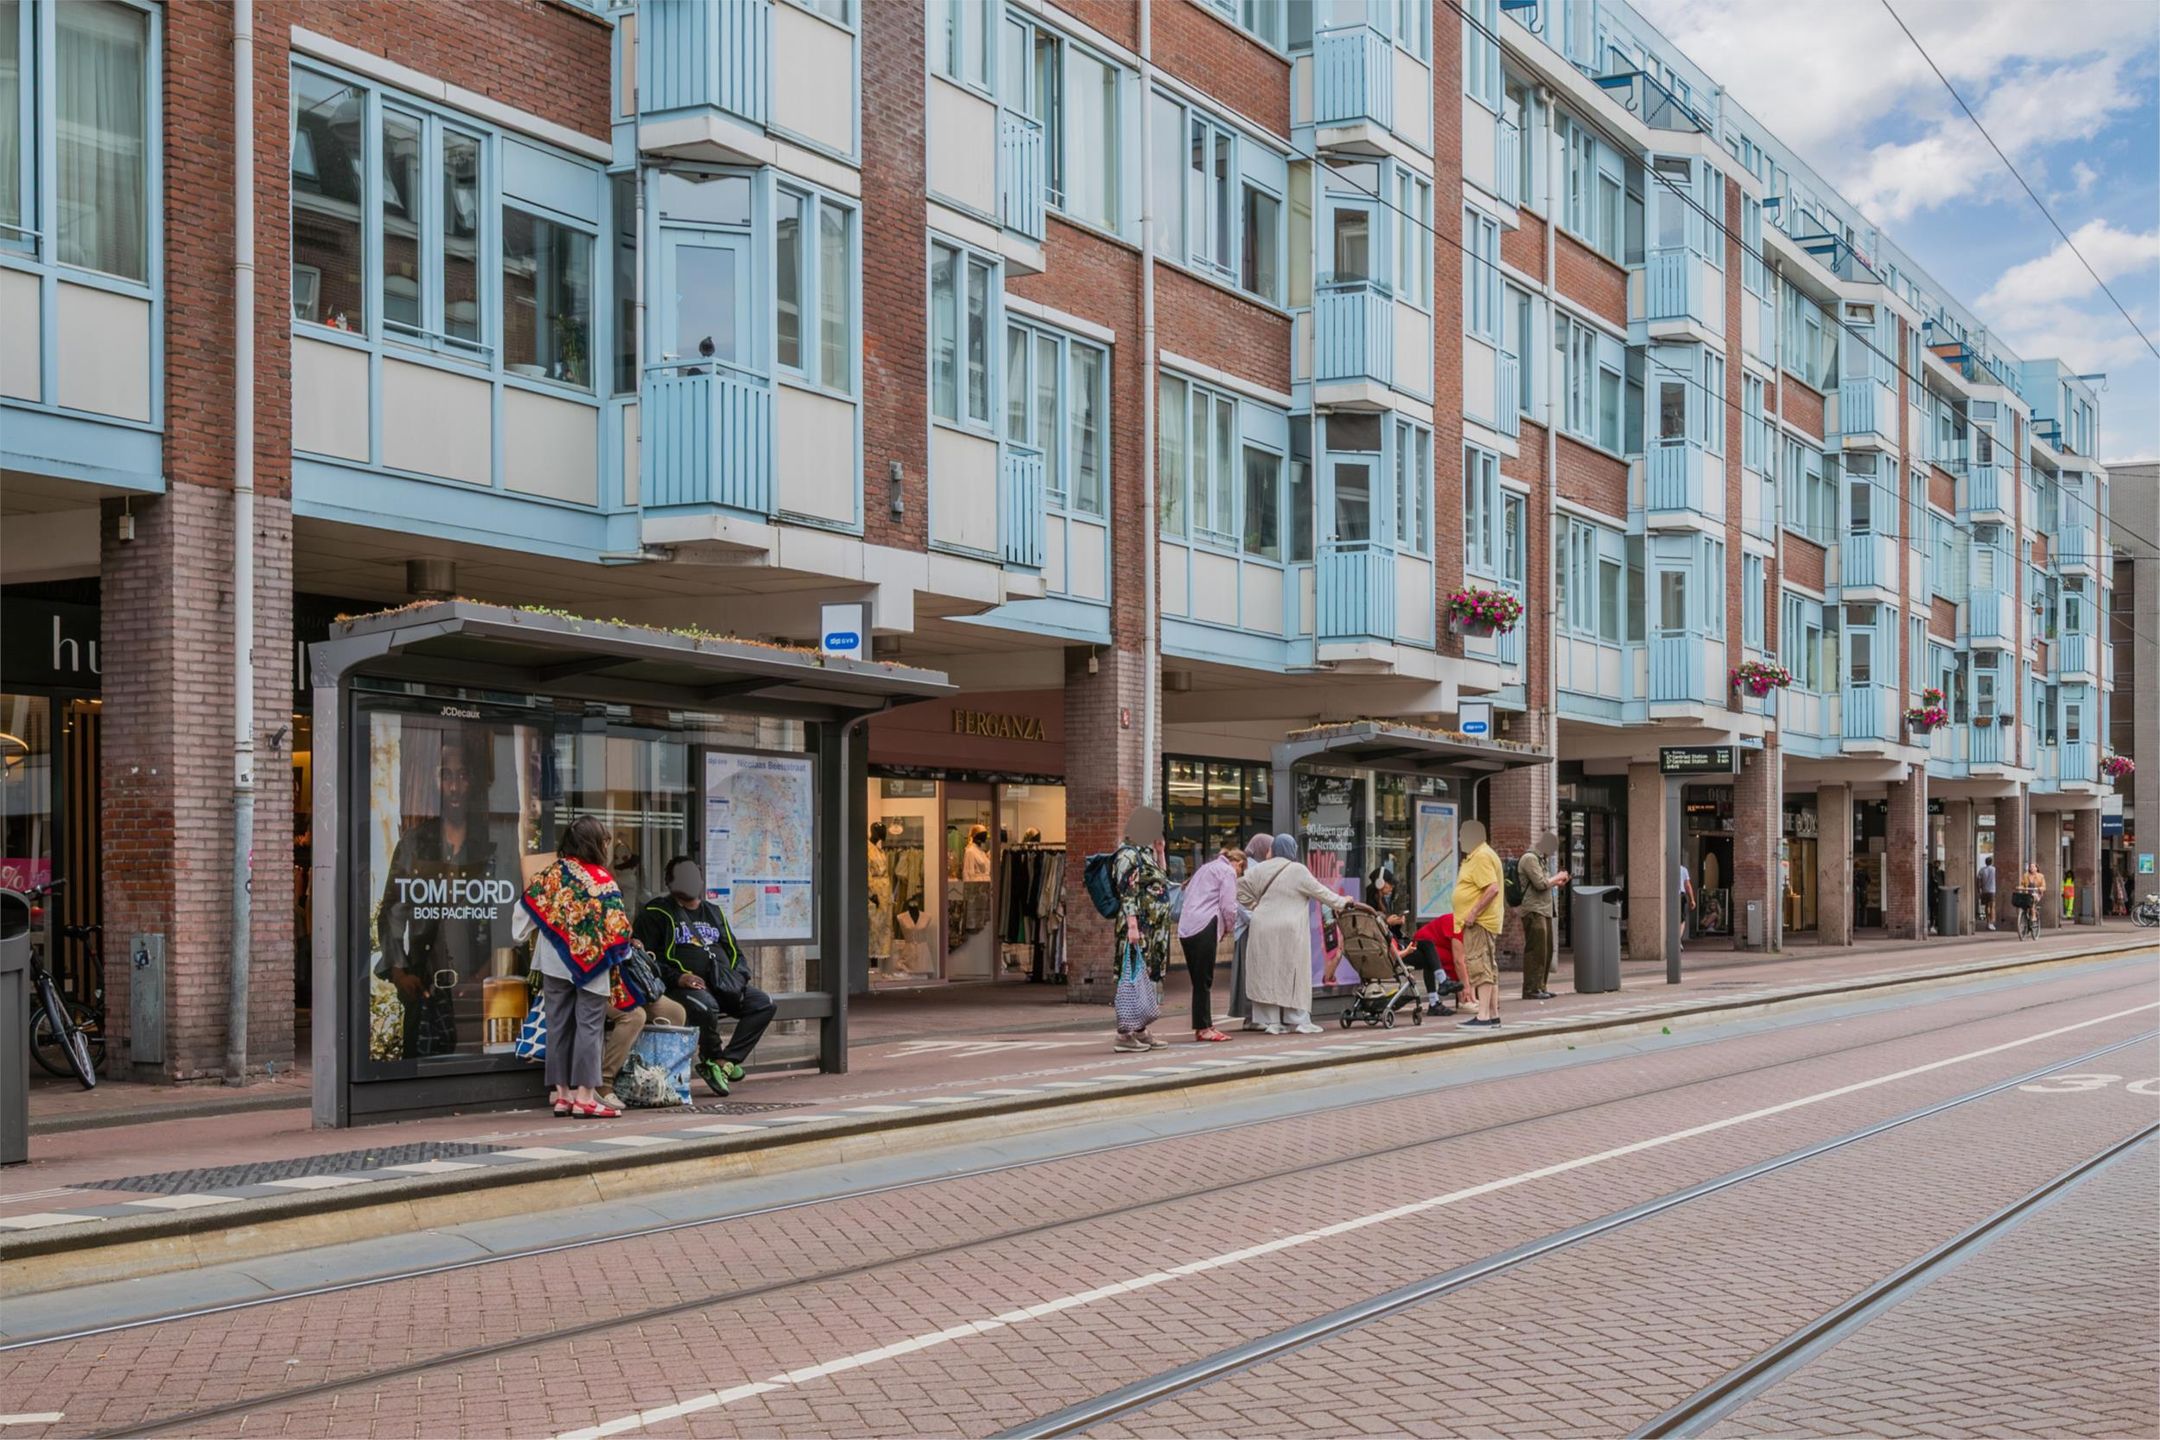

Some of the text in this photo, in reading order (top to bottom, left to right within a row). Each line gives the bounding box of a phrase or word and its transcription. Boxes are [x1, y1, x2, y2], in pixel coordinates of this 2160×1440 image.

[441, 706, 480, 719] JCDecaux
[954, 710, 1047, 741] FERGANZA
[395, 878, 515, 904] TOM FORD
[413, 907, 498, 919] BOIS PACIFIQUE
